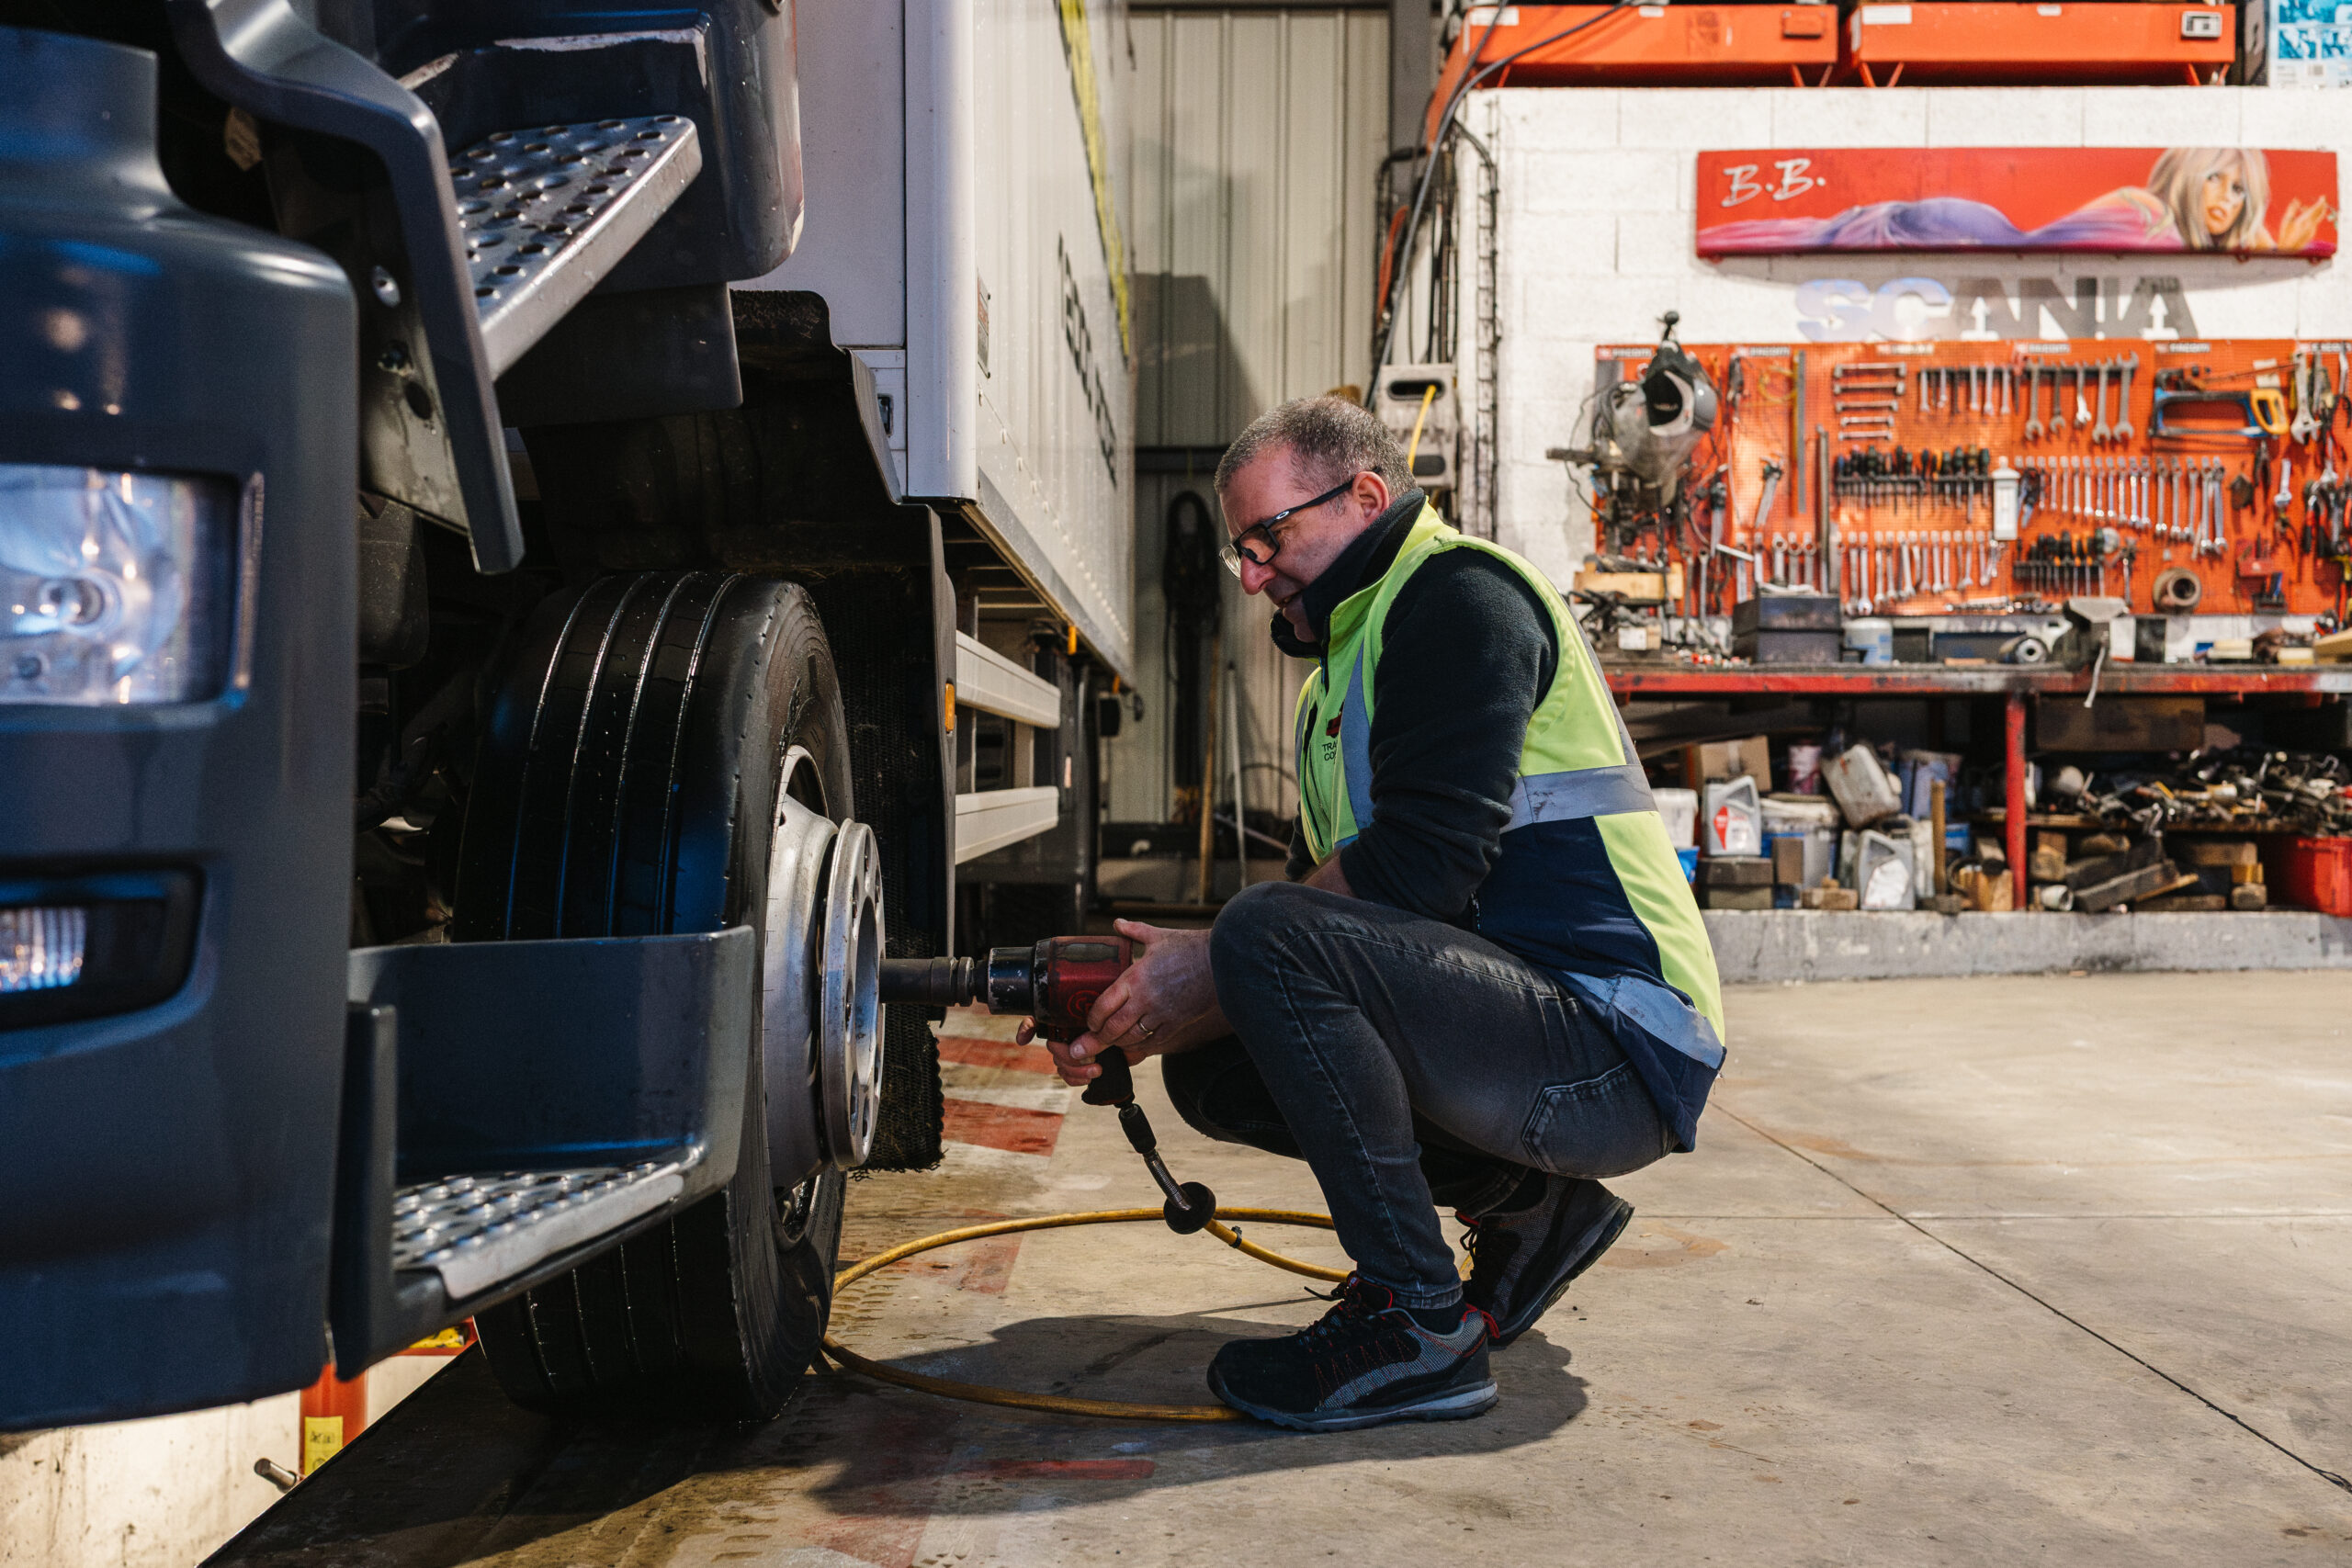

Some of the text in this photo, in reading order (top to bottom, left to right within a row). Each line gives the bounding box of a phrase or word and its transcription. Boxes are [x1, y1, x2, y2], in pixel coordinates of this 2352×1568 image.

[1721, 157, 1826, 207] B.B.
[1794, 276, 2199, 341] SCANIA
[1322, 739, 1338, 752] TRA
[1324, 750, 1337, 761] CO
